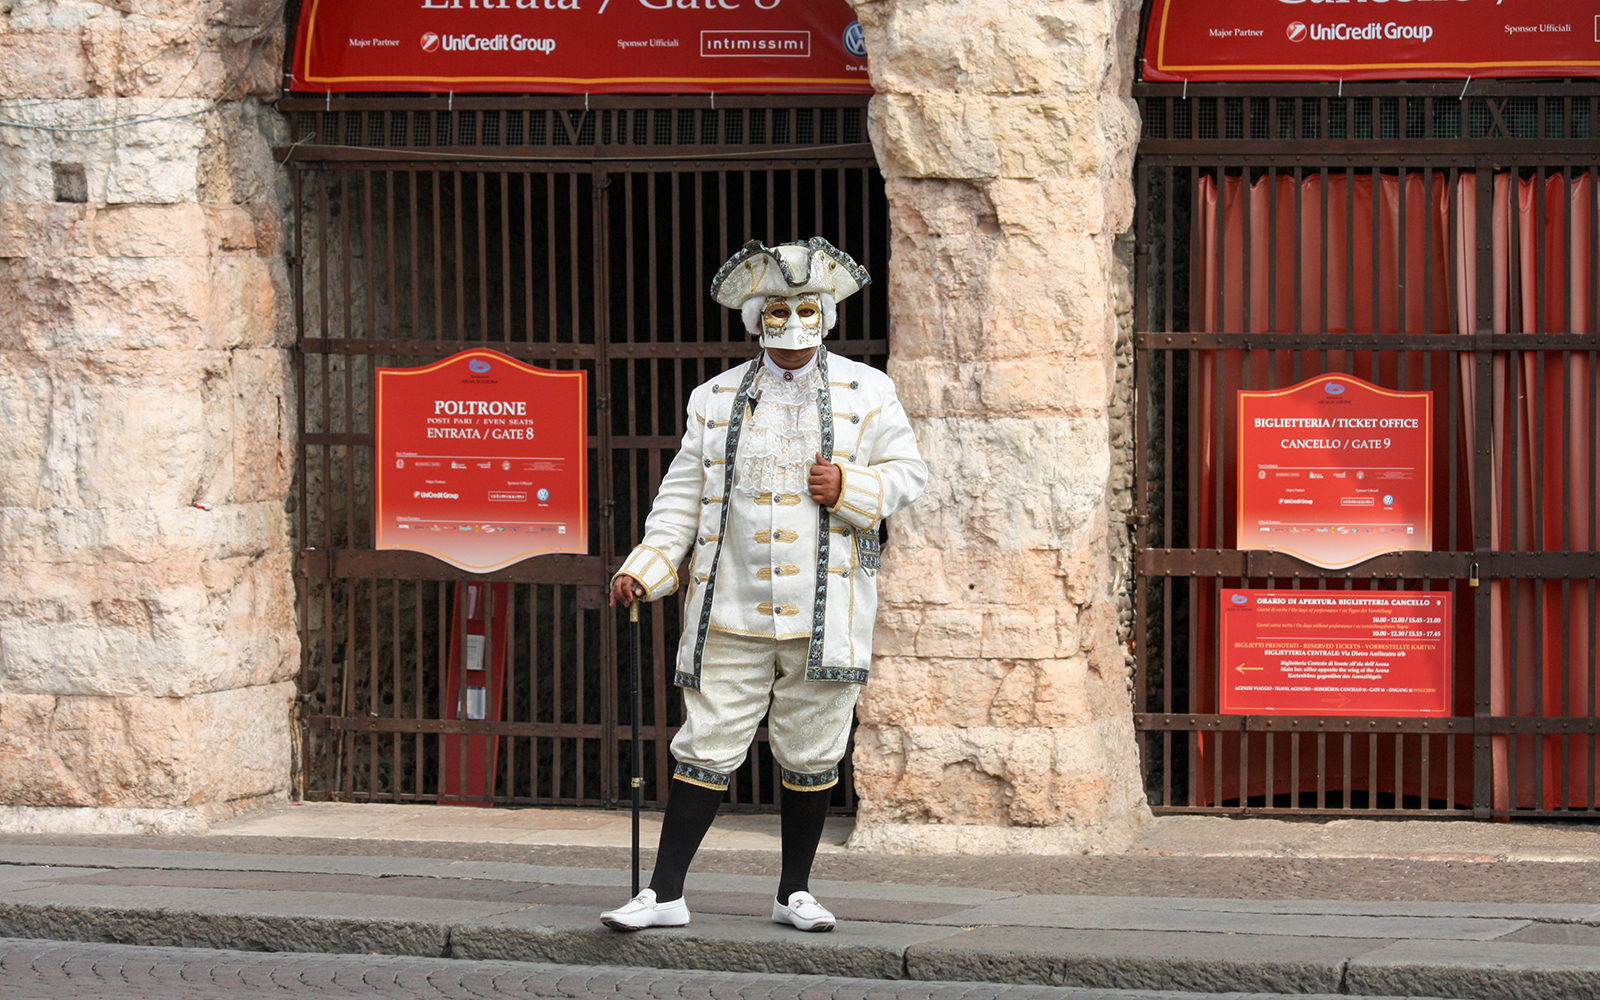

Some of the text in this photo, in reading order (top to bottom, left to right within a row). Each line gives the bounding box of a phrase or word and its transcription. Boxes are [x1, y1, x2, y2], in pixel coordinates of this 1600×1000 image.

[1209, 28, 1264, 38] Major Partner
[1310, 22, 1433, 43] UniCredit Group
[1504, 24, 1572, 34] Sponsor Ufficiali
[349, 38, 400, 49] Major Partner
[442, 34, 556, 55] UniCredit Group
[617, 38, 679, 49] Sponsor Ufficiali
[434, 400, 527, 416] POLTRONE
[1254, 418, 1418, 428] BIGLIETTERIA / TICKET OFFICE
[427, 427, 534, 440] ENTRATA / GATE 8
[1281, 438, 1391, 450] CANCELLO / GATE 9
